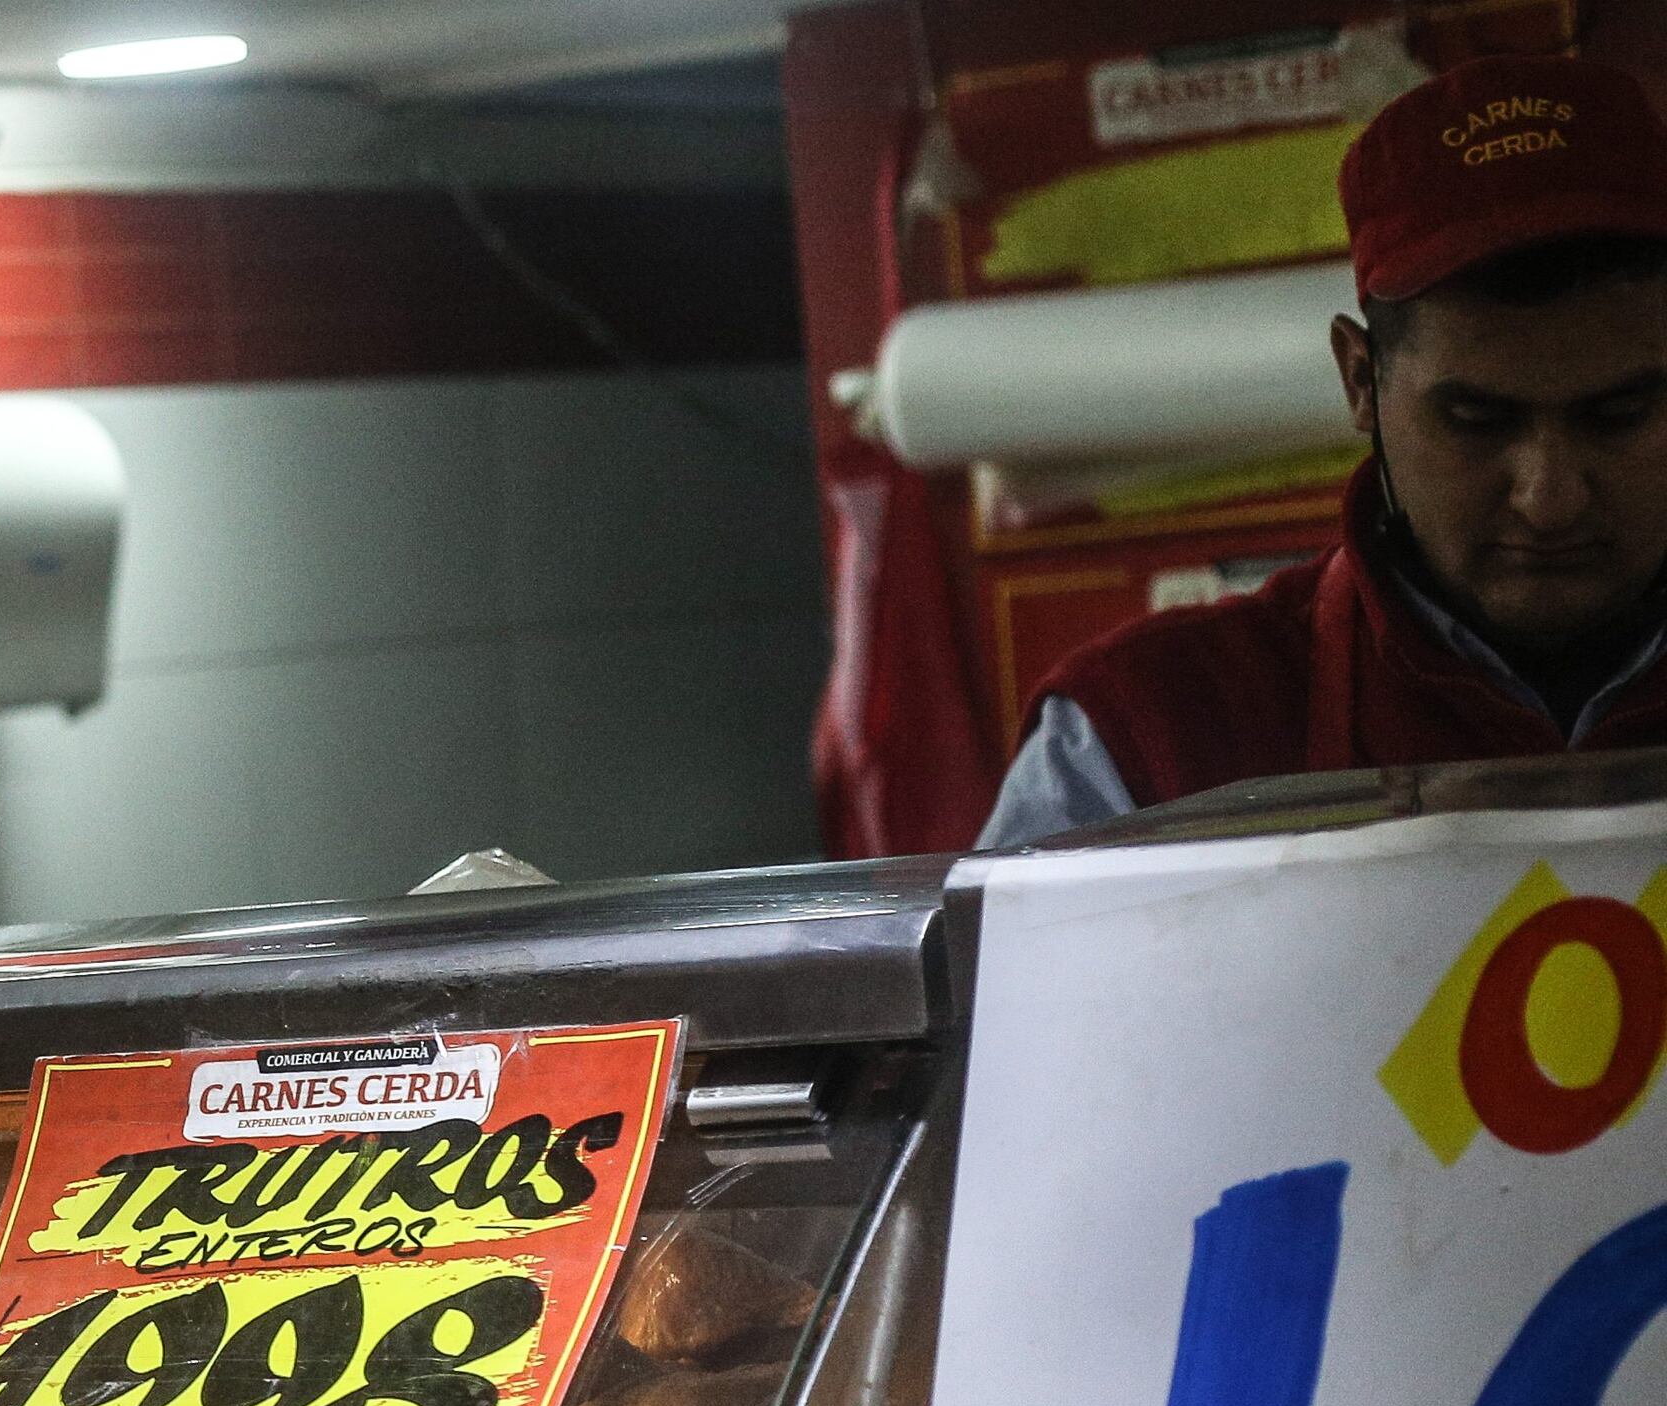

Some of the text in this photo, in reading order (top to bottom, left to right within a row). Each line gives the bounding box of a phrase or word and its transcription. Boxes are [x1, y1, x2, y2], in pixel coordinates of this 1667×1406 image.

[1442, 96, 1575, 147] CARNES
[1465, 129, 1567, 165] CERDA
[266, 1052, 341, 1068] COMERCIAL
[342, 1051, 354, 1062] Y
[199, 1069, 485, 1115] CARNES CERDA
[237, 1109, 437, 1129] EXPERIENCIA Y TRADICIÓN EN CARNES
[77, 1111, 624, 1239] TRUTROS
[135, 1217, 437, 1274] ENTEROS
